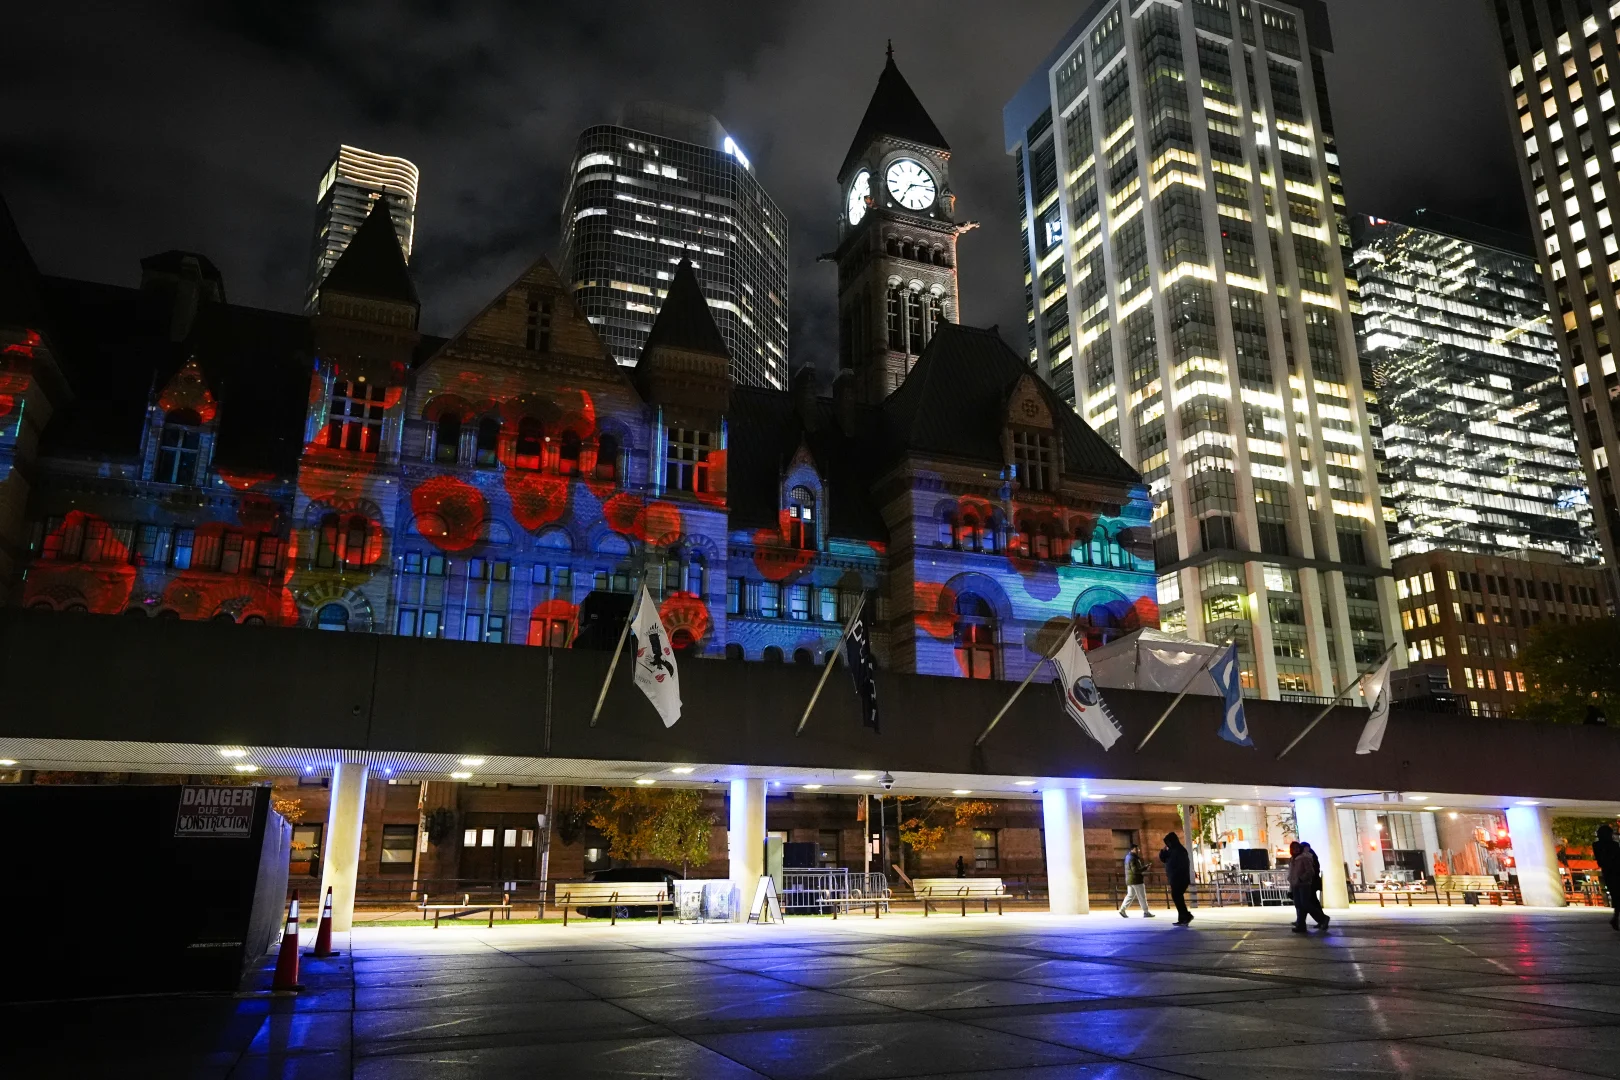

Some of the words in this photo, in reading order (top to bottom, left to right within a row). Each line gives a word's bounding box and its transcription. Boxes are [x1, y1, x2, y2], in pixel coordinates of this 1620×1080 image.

[182, 788, 254, 806] DANGER
[198, 806, 219, 814] DUE
[221, 806, 235, 815] TO
[178, 815, 250, 831] CONSTRUCTION
